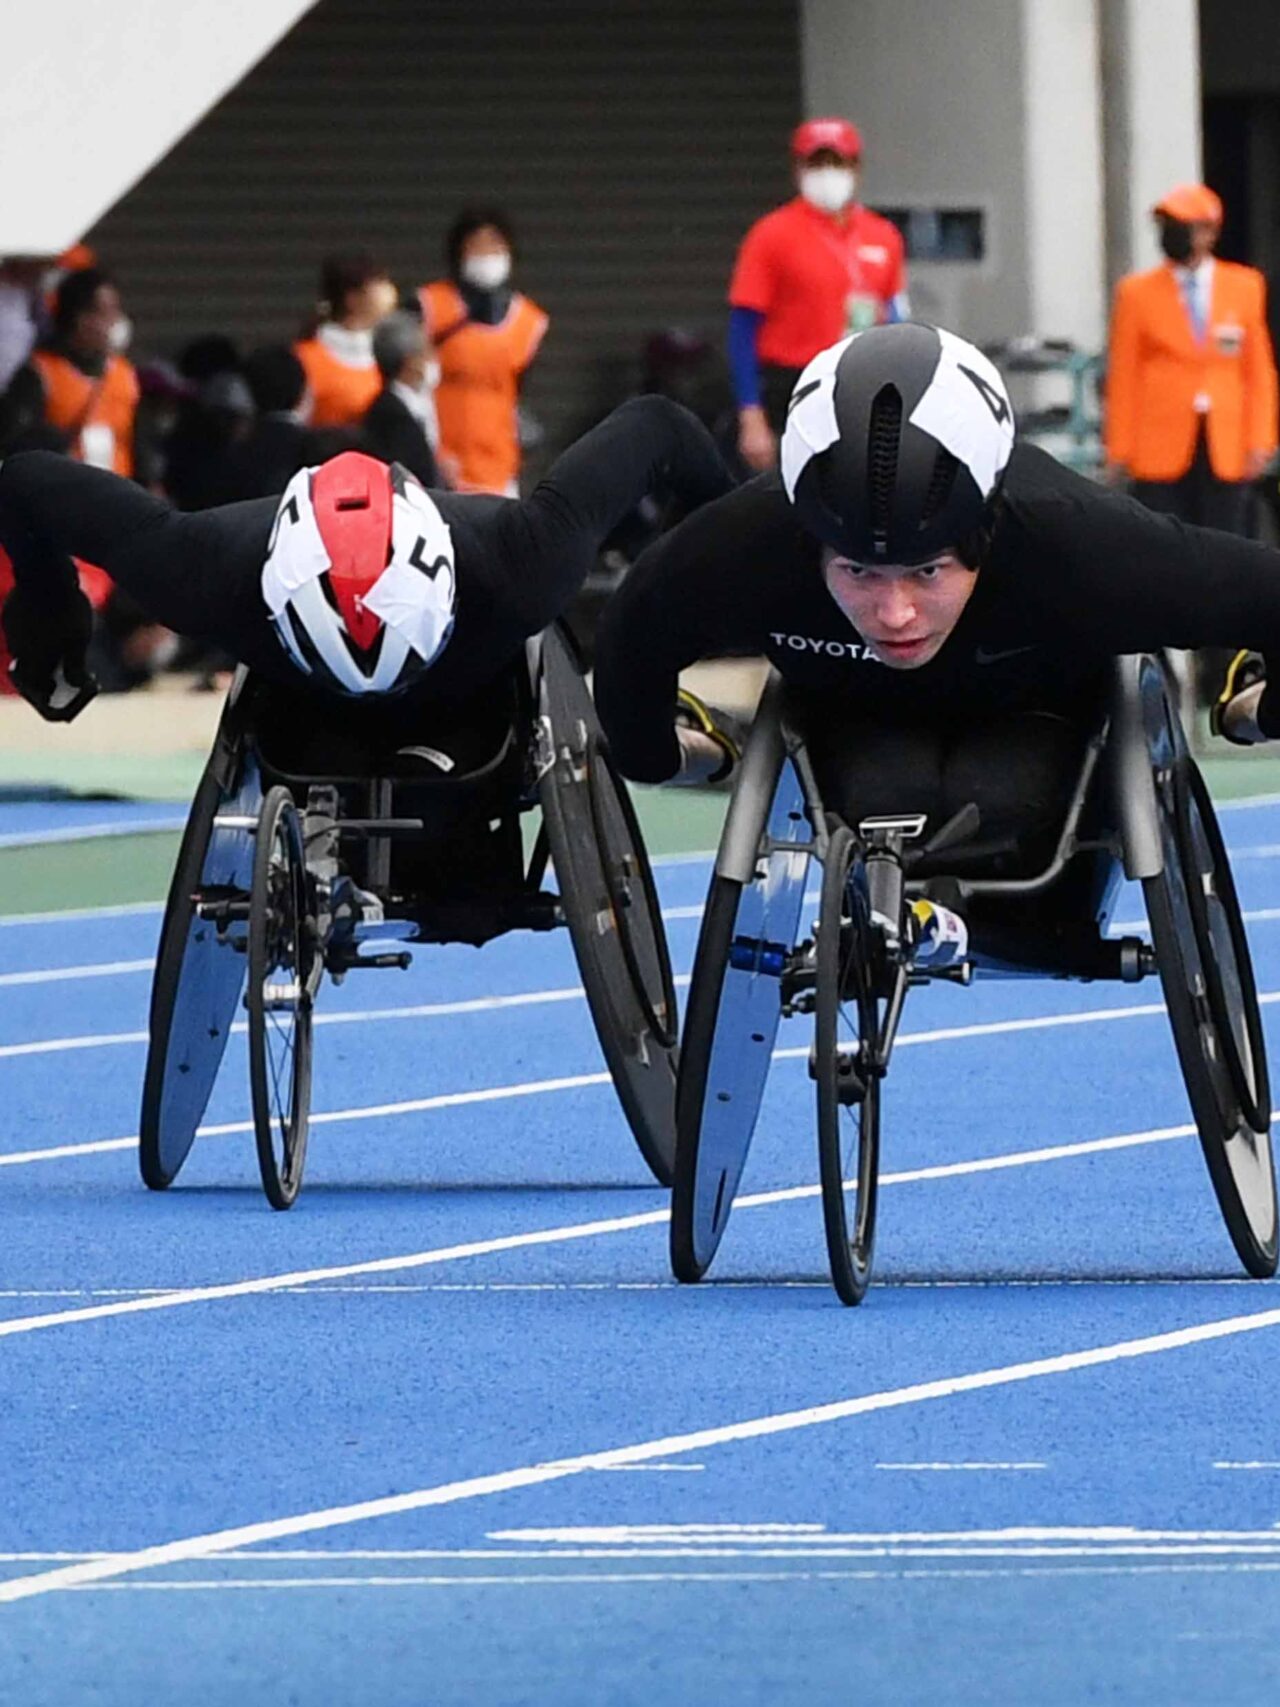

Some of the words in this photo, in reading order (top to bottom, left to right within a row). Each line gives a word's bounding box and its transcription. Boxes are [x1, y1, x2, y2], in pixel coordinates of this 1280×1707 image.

[956, 362, 1011, 426] 4
[408, 535, 454, 603] 5
[769, 632, 881, 662] TOYOTA
